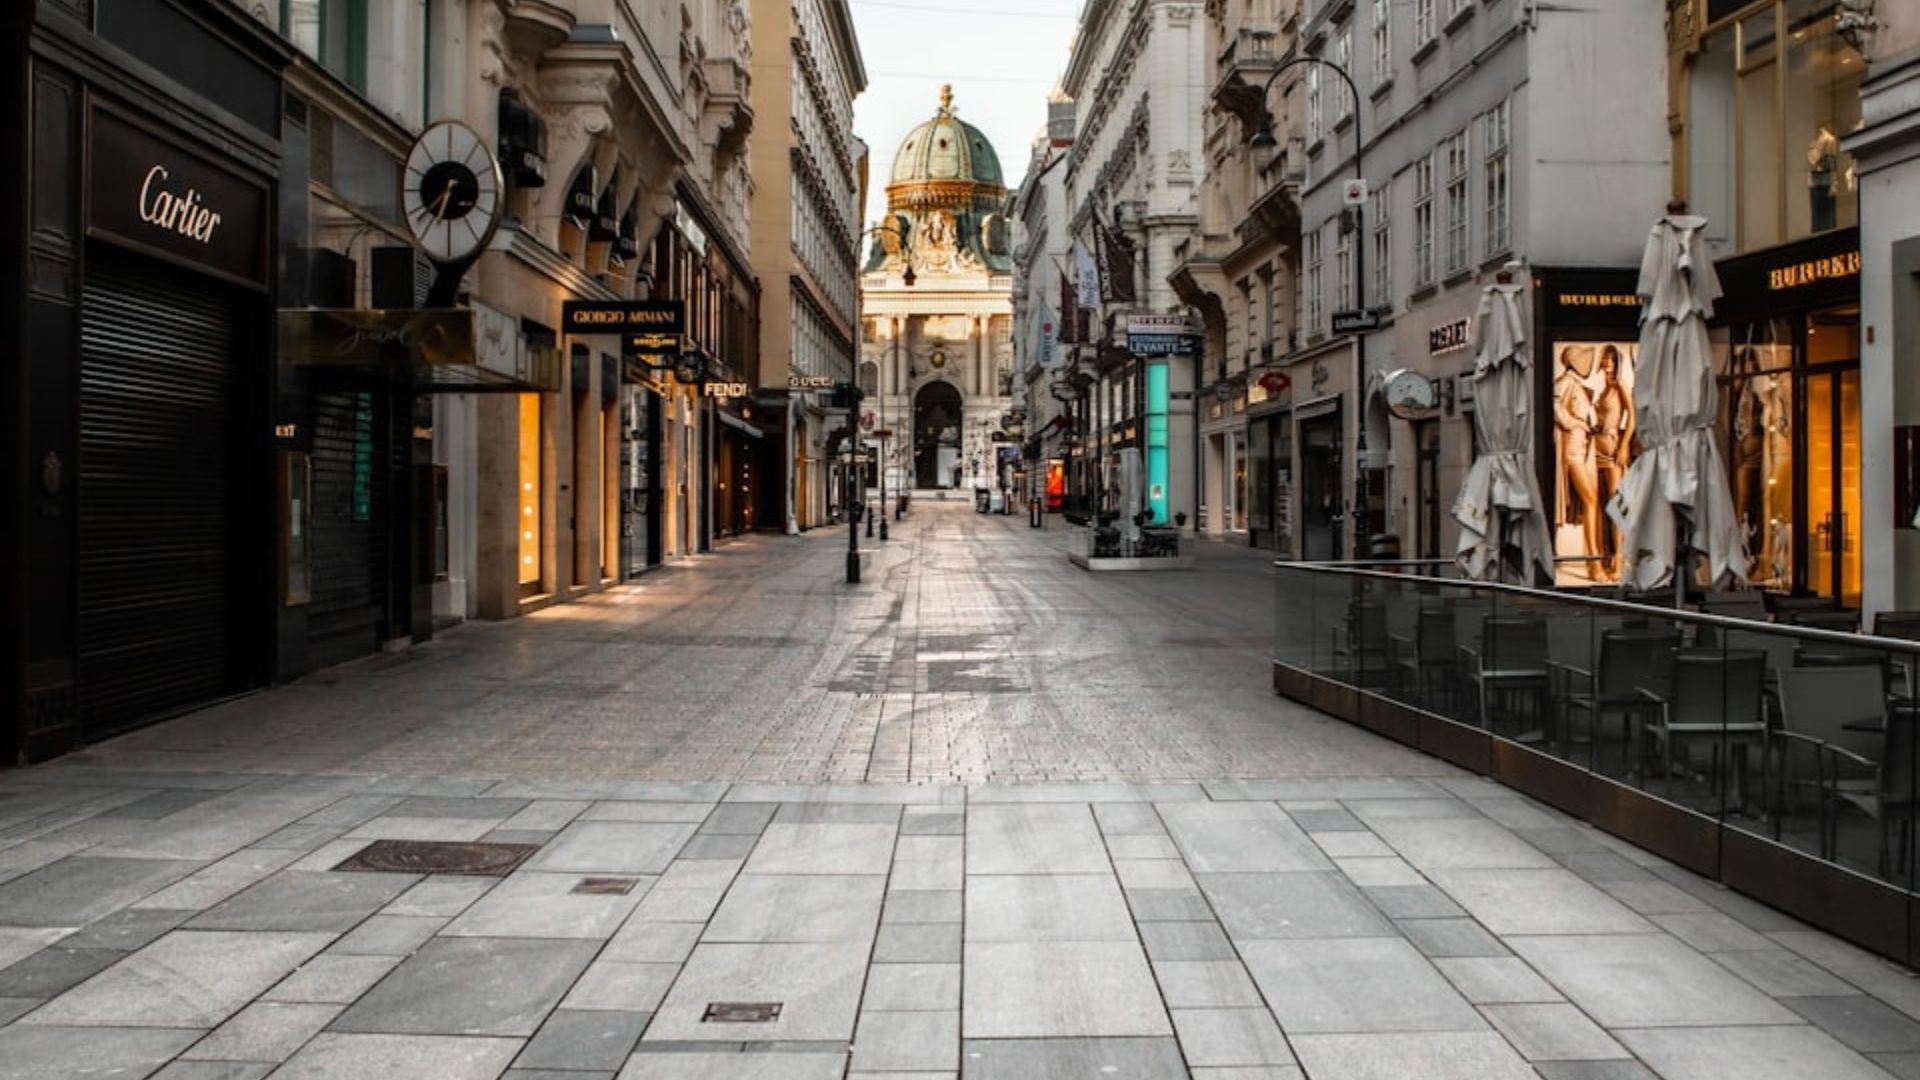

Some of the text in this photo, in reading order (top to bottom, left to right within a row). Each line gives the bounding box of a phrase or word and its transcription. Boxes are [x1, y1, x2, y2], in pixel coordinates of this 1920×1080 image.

[139, 164, 221, 245] Cartier
[573, 310, 675, 324] GIORGIO ARMANI
[1130, 342, 1178, 353] LEVANTE
[704, 382, 747, 397] FENDI
